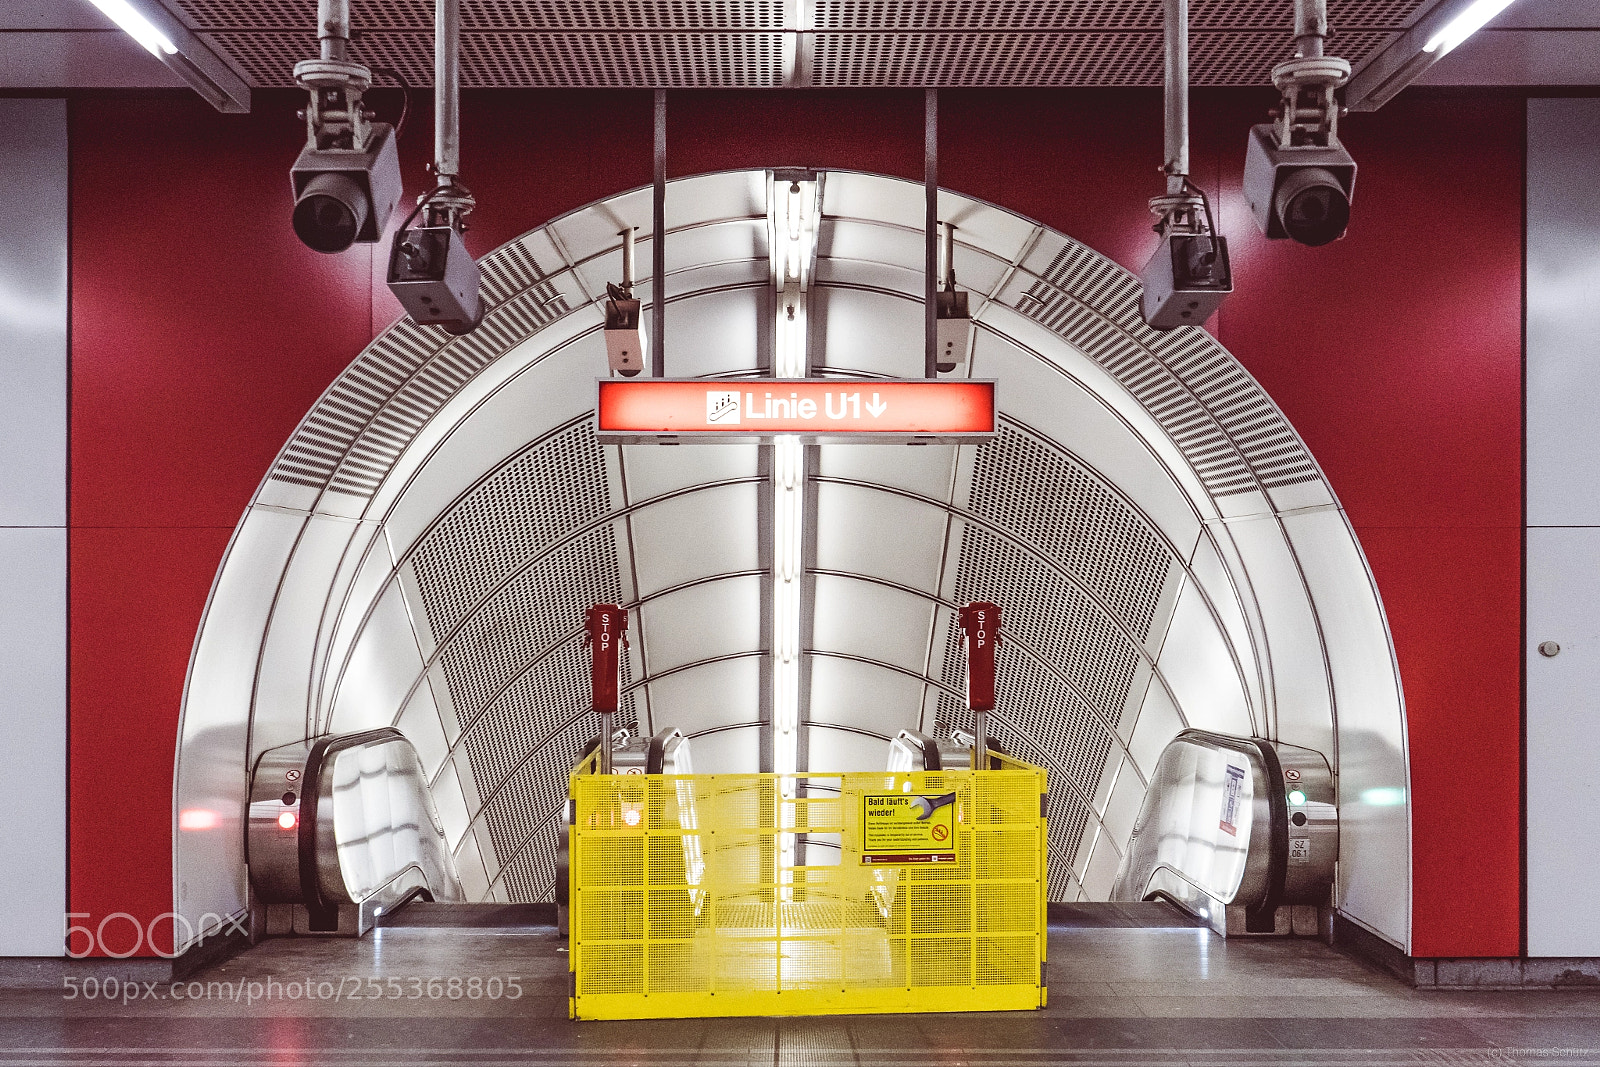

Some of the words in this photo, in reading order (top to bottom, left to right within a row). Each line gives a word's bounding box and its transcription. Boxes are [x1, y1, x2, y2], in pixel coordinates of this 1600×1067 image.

[745, 392, 818, 420] Linie
[824, 392, 861, 420] U1
[600, 613, 610, 652] STOP
[977, 610, 986, 649] STOP
[868, 797, 885, 806] Bald
[868, 808, 895, 817] wieder!
[1294, 840, 1305, 849] SZ
